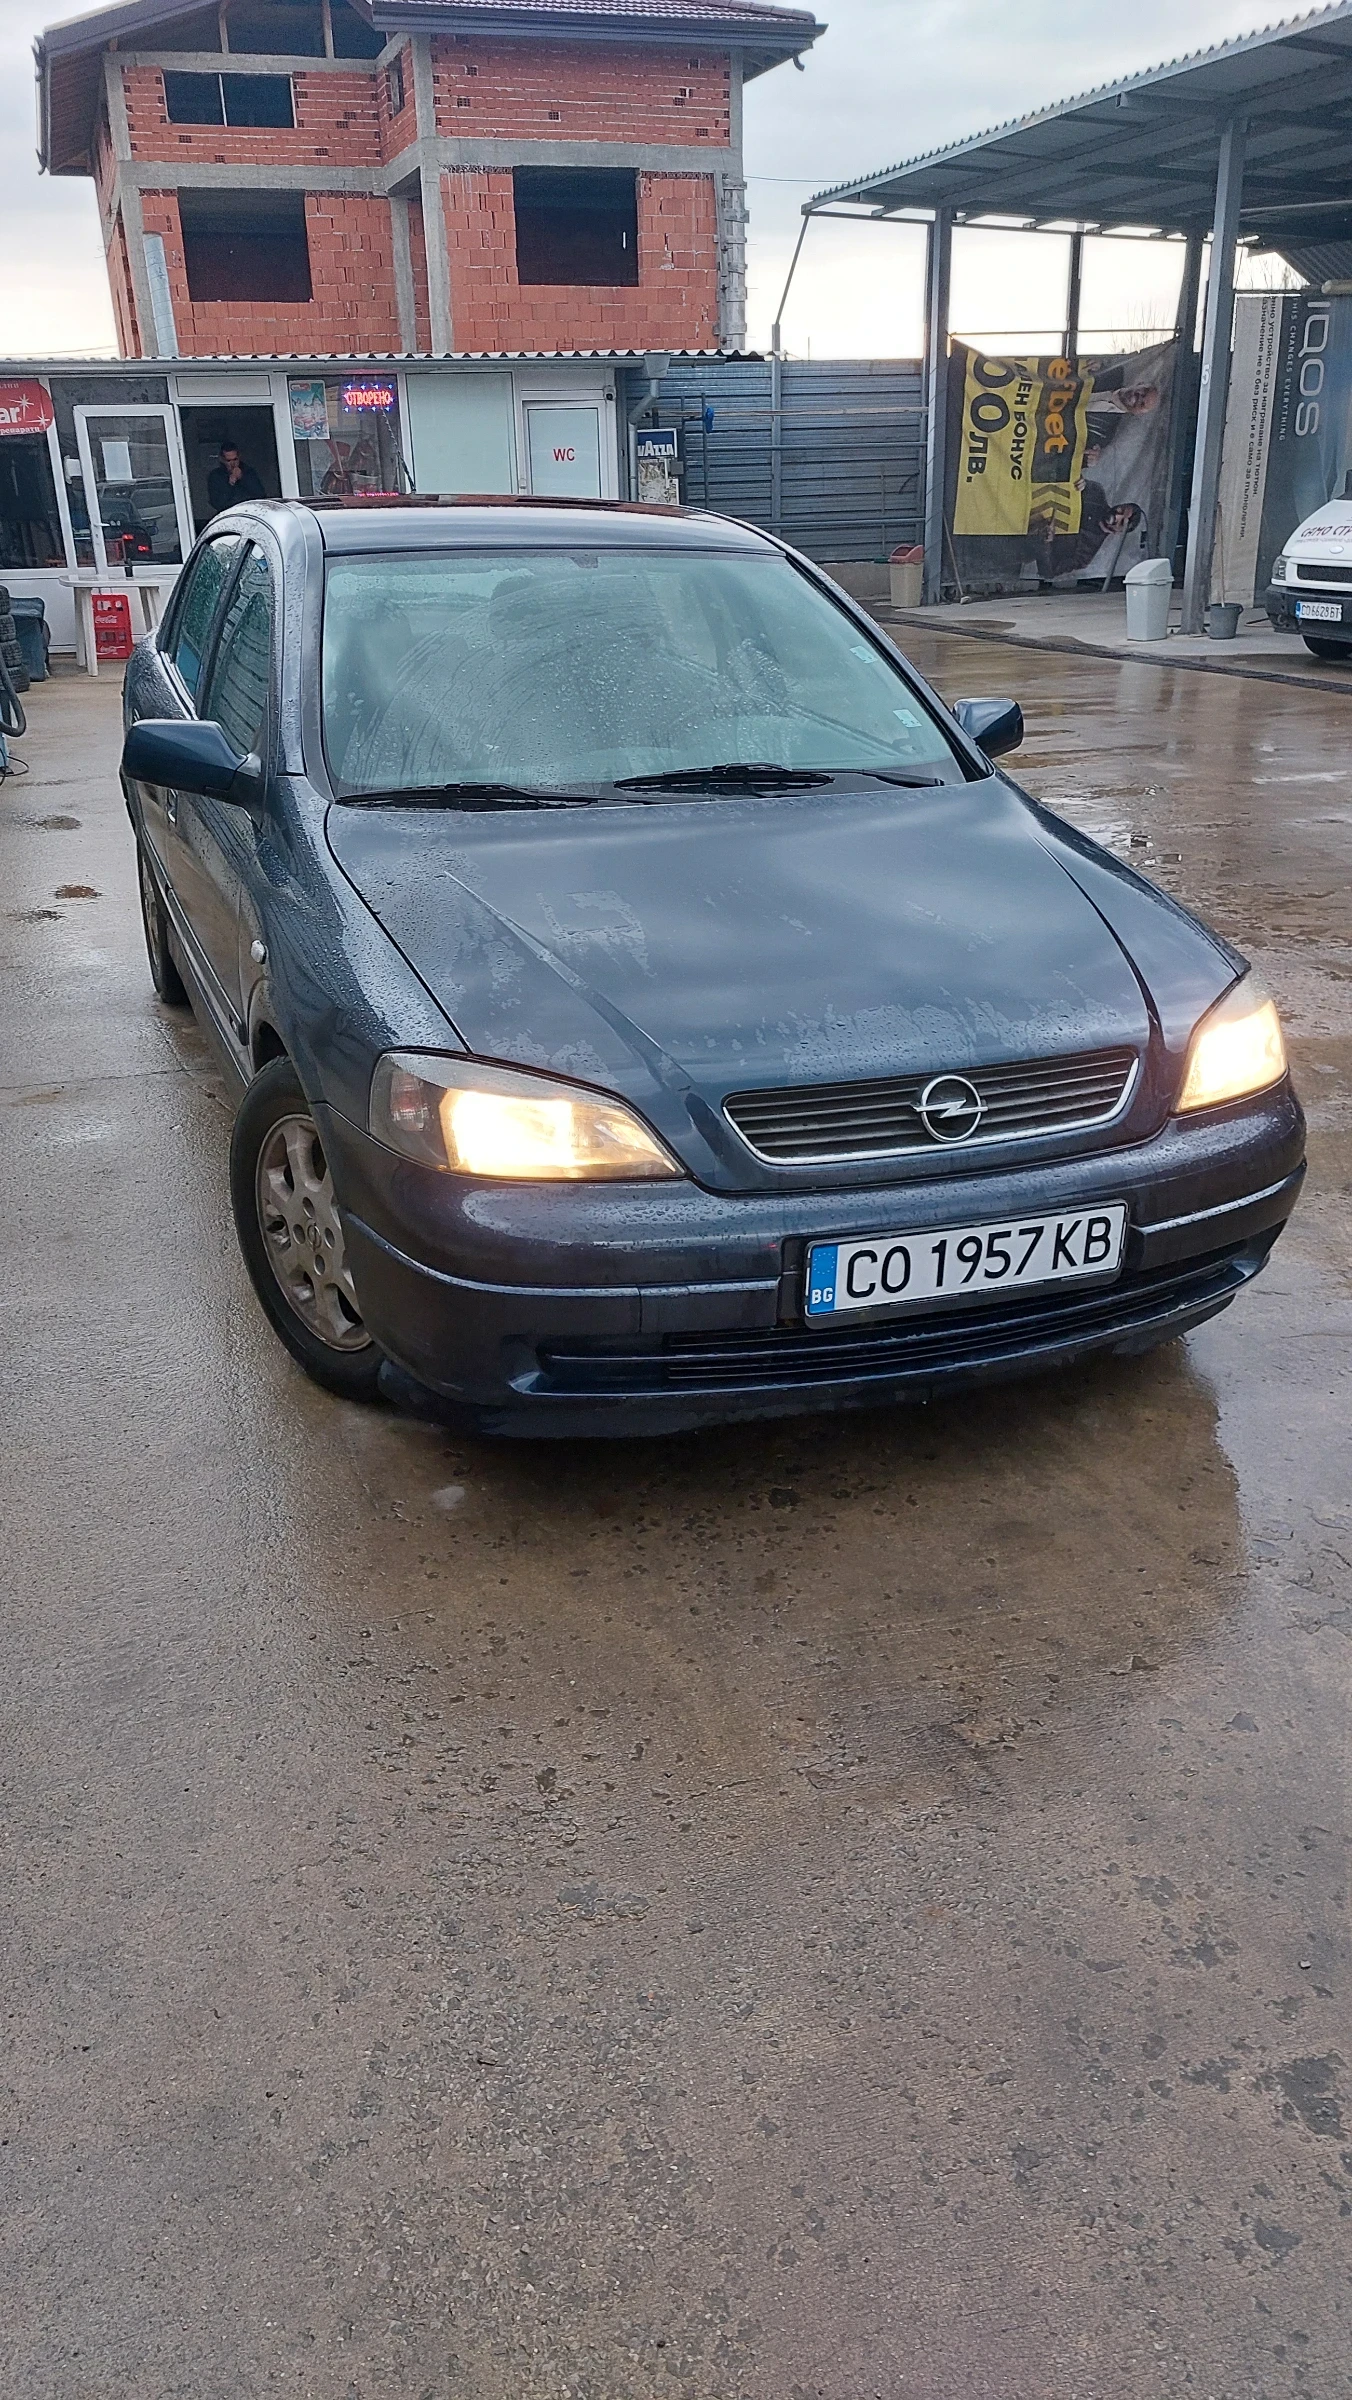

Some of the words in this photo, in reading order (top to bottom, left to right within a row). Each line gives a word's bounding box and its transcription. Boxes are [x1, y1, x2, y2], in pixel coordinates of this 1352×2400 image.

[1256, 355, 1263, 367] не
[1264, 321, 1275, 379] устройство
[1286, 325, 1297, 373] CHANGES
[1295, 302, 1331, 436] IQOS
[346, 390, 391, 406] ОТВОРЕНО
[1253, 378, 1262, 396] без
[1250, 398, 1259, 422] риск
[1279, 378, 1292, 441] EVERYTHING
[553, 448, 575, 461] WC
[1010, 411, 1028, 480] БОНУС
[1247, 441, 1255, 466] само
[1301, 526, 1333, 538] САМО
[846, 1245, 911, 1299] CO
[931, 1225, 1045, 1287] 1957
[1051, 1216, 1111, 1270] KB
[812, 1286, 833, 1304] BG
